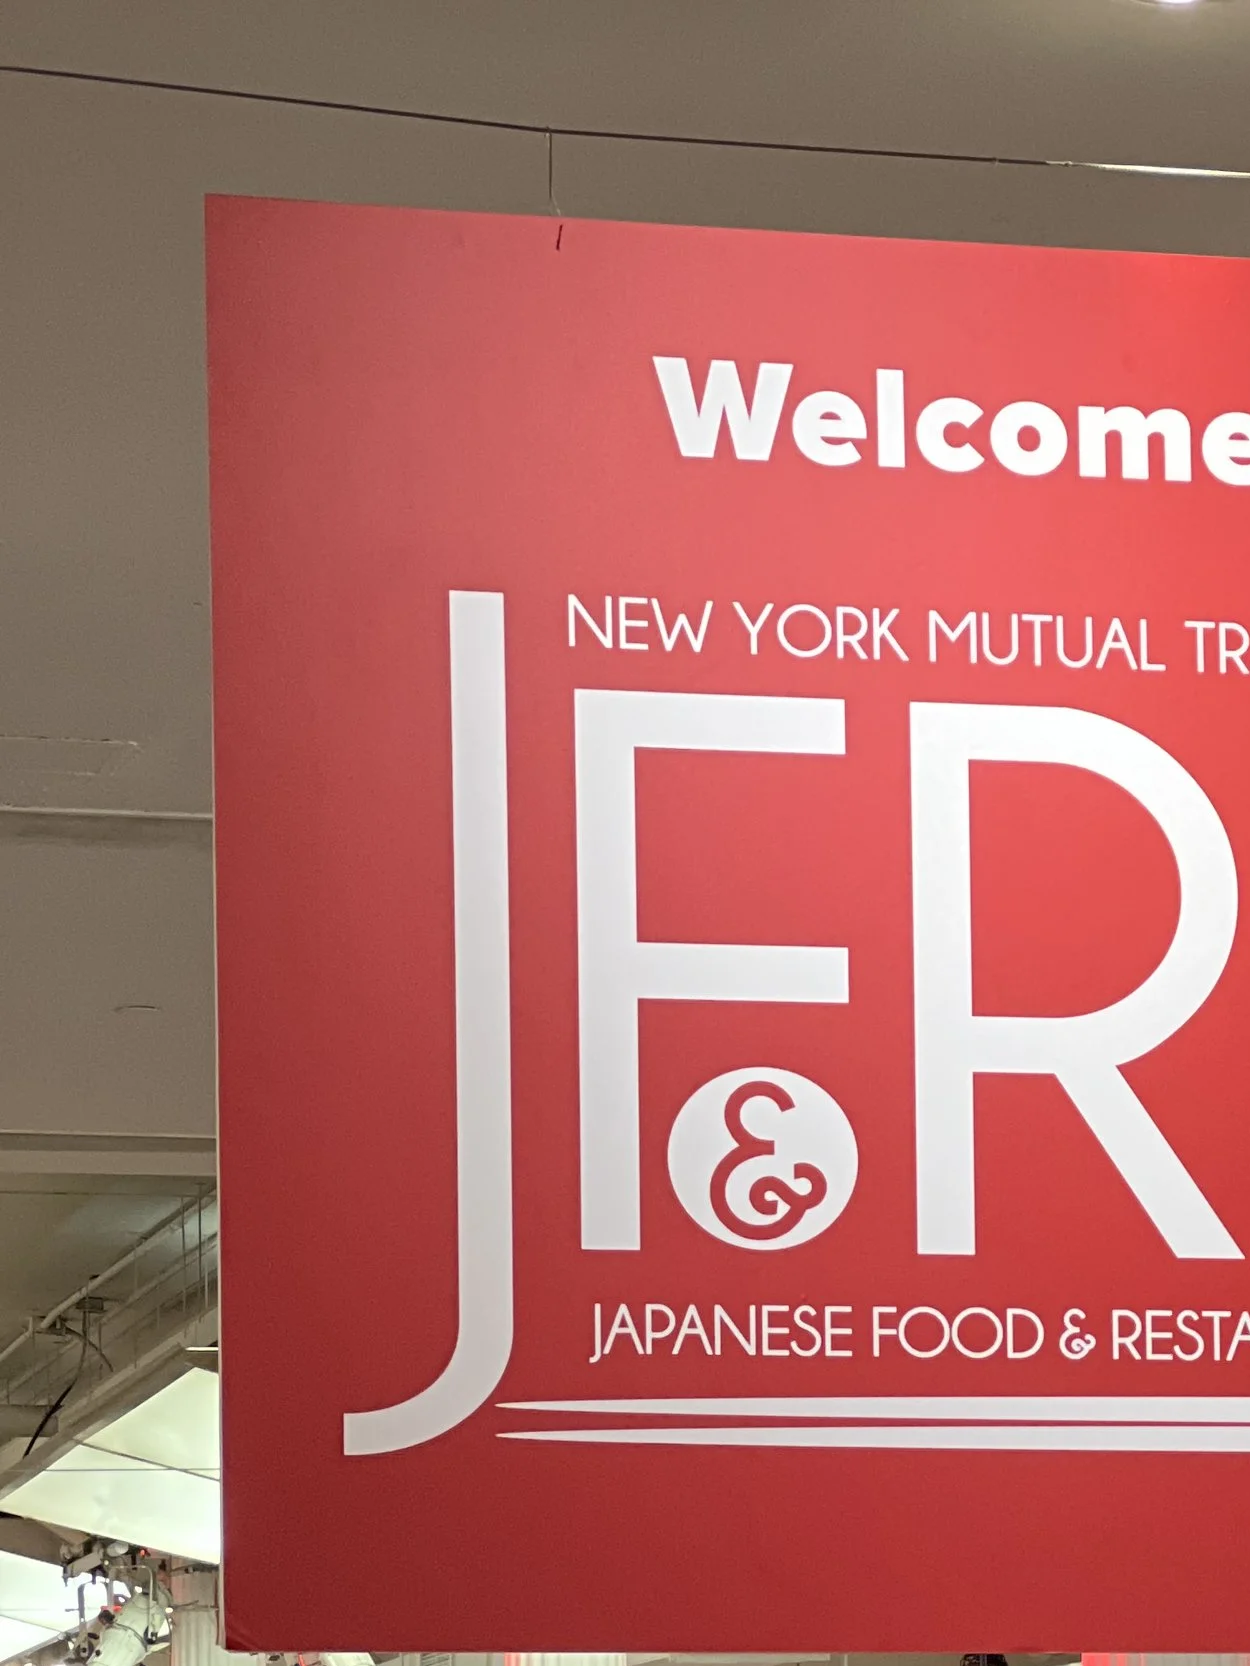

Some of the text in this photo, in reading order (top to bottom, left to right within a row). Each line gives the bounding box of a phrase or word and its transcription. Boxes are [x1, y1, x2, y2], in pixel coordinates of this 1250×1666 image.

[568, 594, 713, 653] NEW
[732, 602, 909, 661] YORK
[929, 610, 1166, 671] MUTUAL
[700, 1076, 836, 1243] &
[588, 1304, 852, 1363] JAPANESE
[873, 1307, 1044, 1358] FOOD
[1059, 1309, 1096, 1359] &
